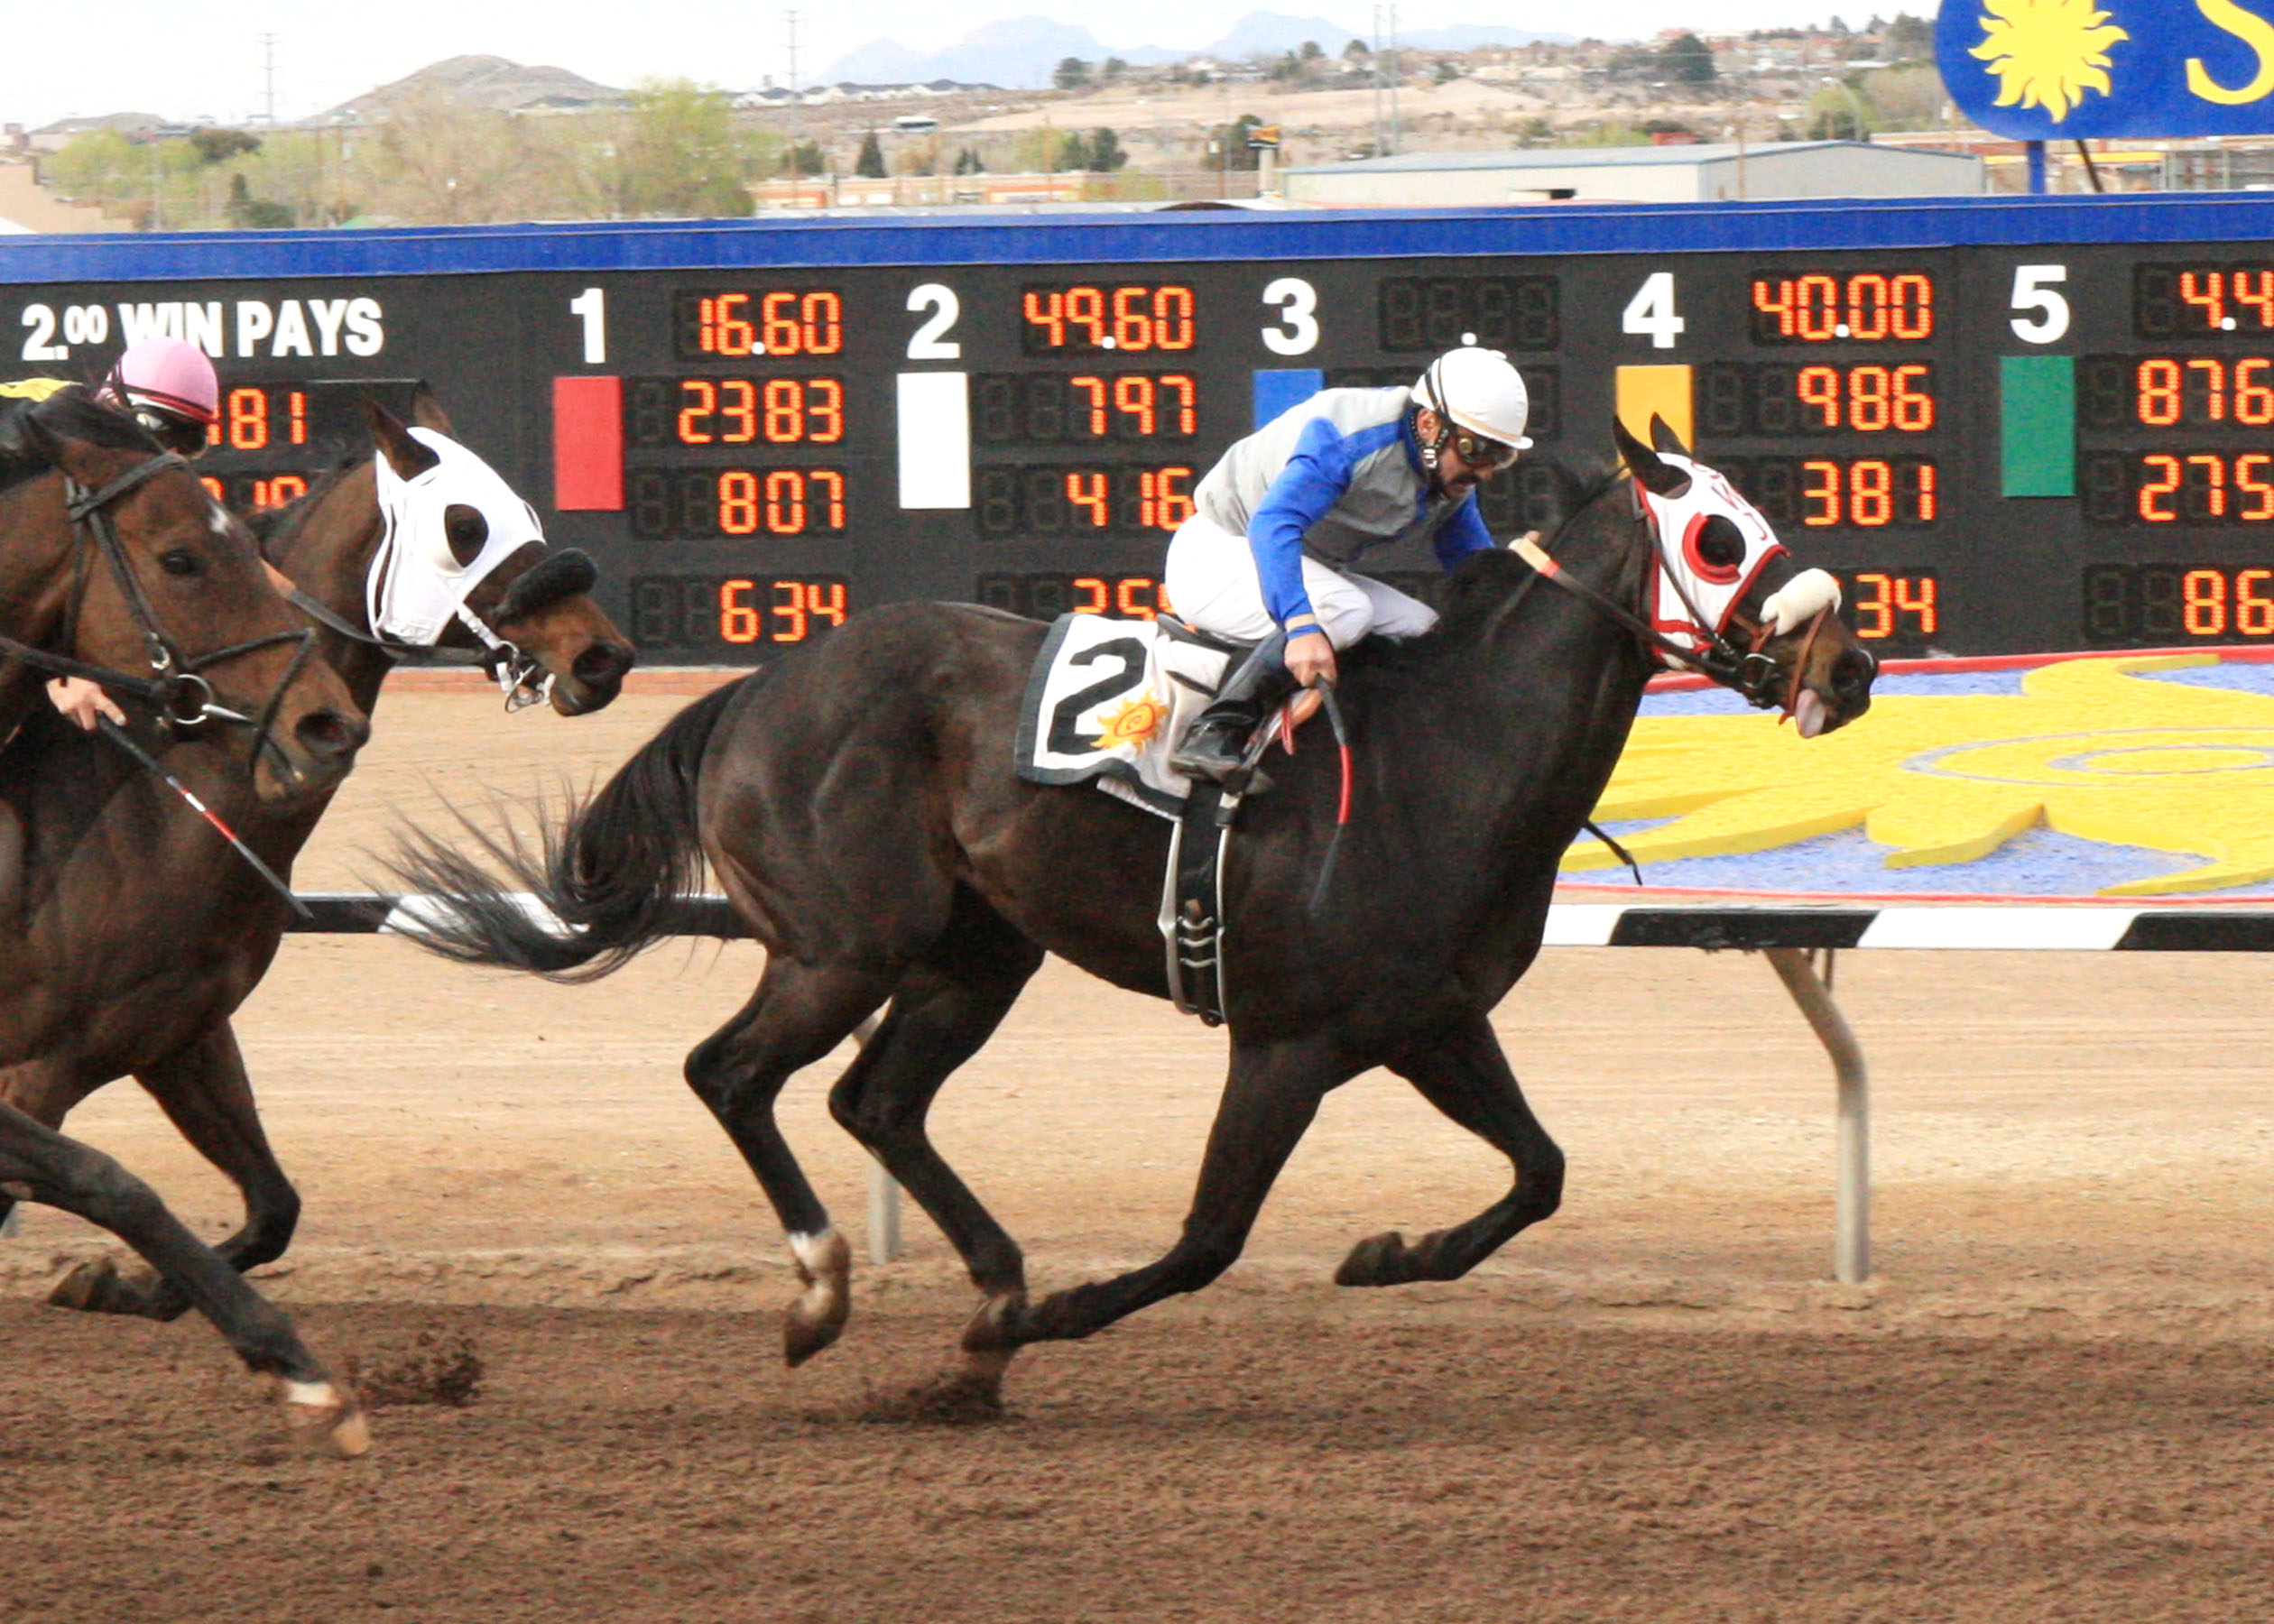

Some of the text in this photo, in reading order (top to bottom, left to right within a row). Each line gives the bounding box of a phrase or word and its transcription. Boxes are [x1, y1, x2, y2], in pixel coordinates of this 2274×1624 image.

[118, 301, 223, 357] WIN
[236, 298, 383, 357] PAYS
[571, 288, 605, 364] 1
[700, 292, 842, 355] 16.60
[907, 283, 960, 359] 2
[1024, 286, 1194, 351] 49.60
[1262, 278, 1318, 355] 3
[1623, 272, 1684, 348] 4
[1754, 274, 1932, 340] 40.00
[2011, 265, 2070, 344] 5
[679, 380, 843, 443] 2383
[1071, 375, 1196, 434] 797
[1798, 365, 1934, 431] 986
[2138, 358, 2274, 426] 876
[718, 471, 845, 534] 807
[1067, 467, 1196, 531] 416
[1804, 461, 1935, 526] 381
[2140, 454, 2274, 521] 275
[720, 580, 846, 642] 634
[1834, 574, 1937, 638] 34
[2183, 569, 2274, 635] 86
[1048, 637, 1148, 754] 2
